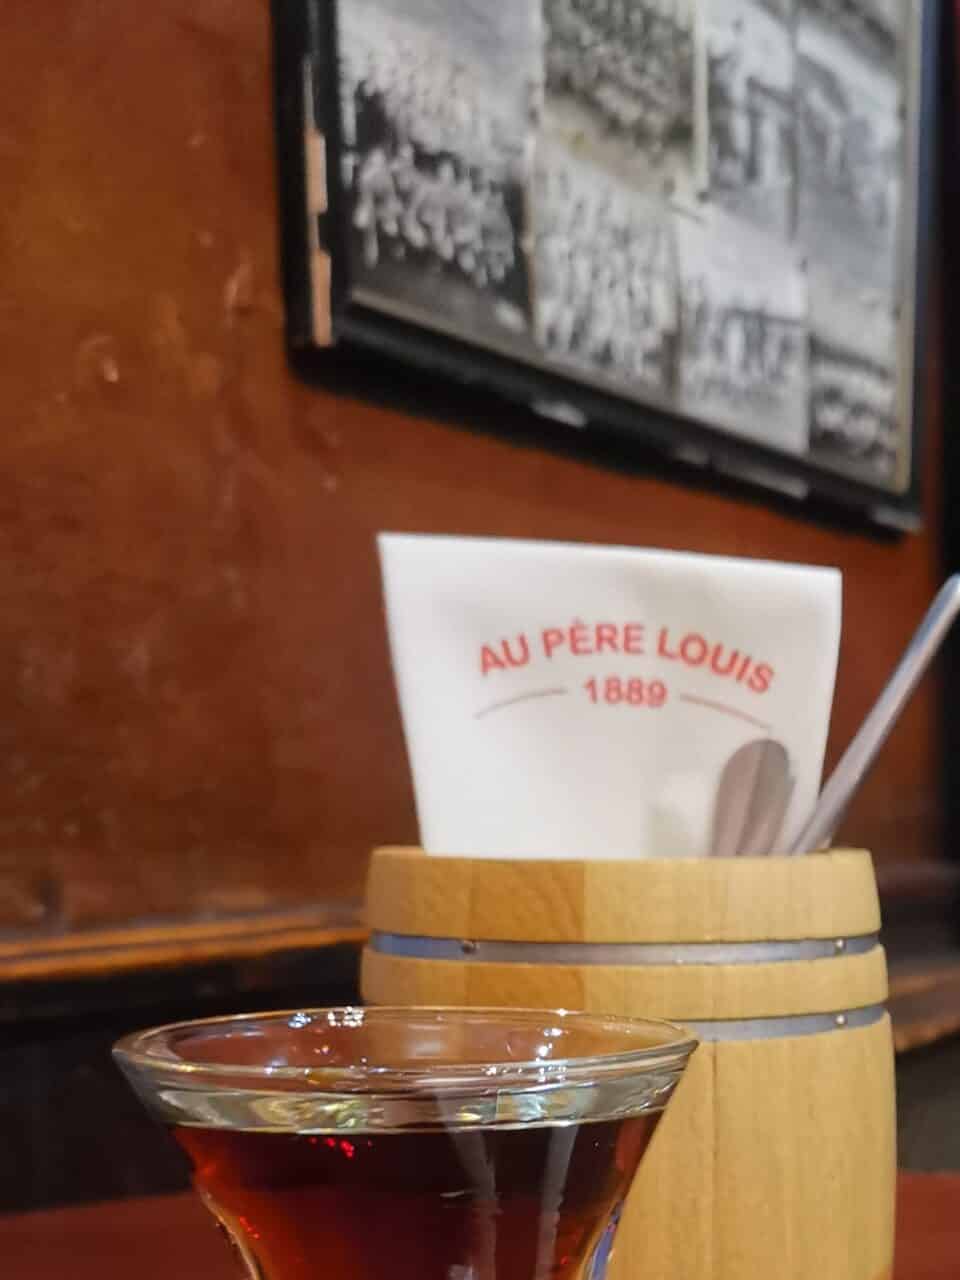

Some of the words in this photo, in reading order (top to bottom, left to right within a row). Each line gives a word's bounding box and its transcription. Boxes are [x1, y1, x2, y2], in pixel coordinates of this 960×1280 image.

[479, 634, 530, 676] AU
[542, 617, 645, 659] PÈRE
[657, 627, 775, 694] LOUIS
[583, 674, 668, 708] 1889
